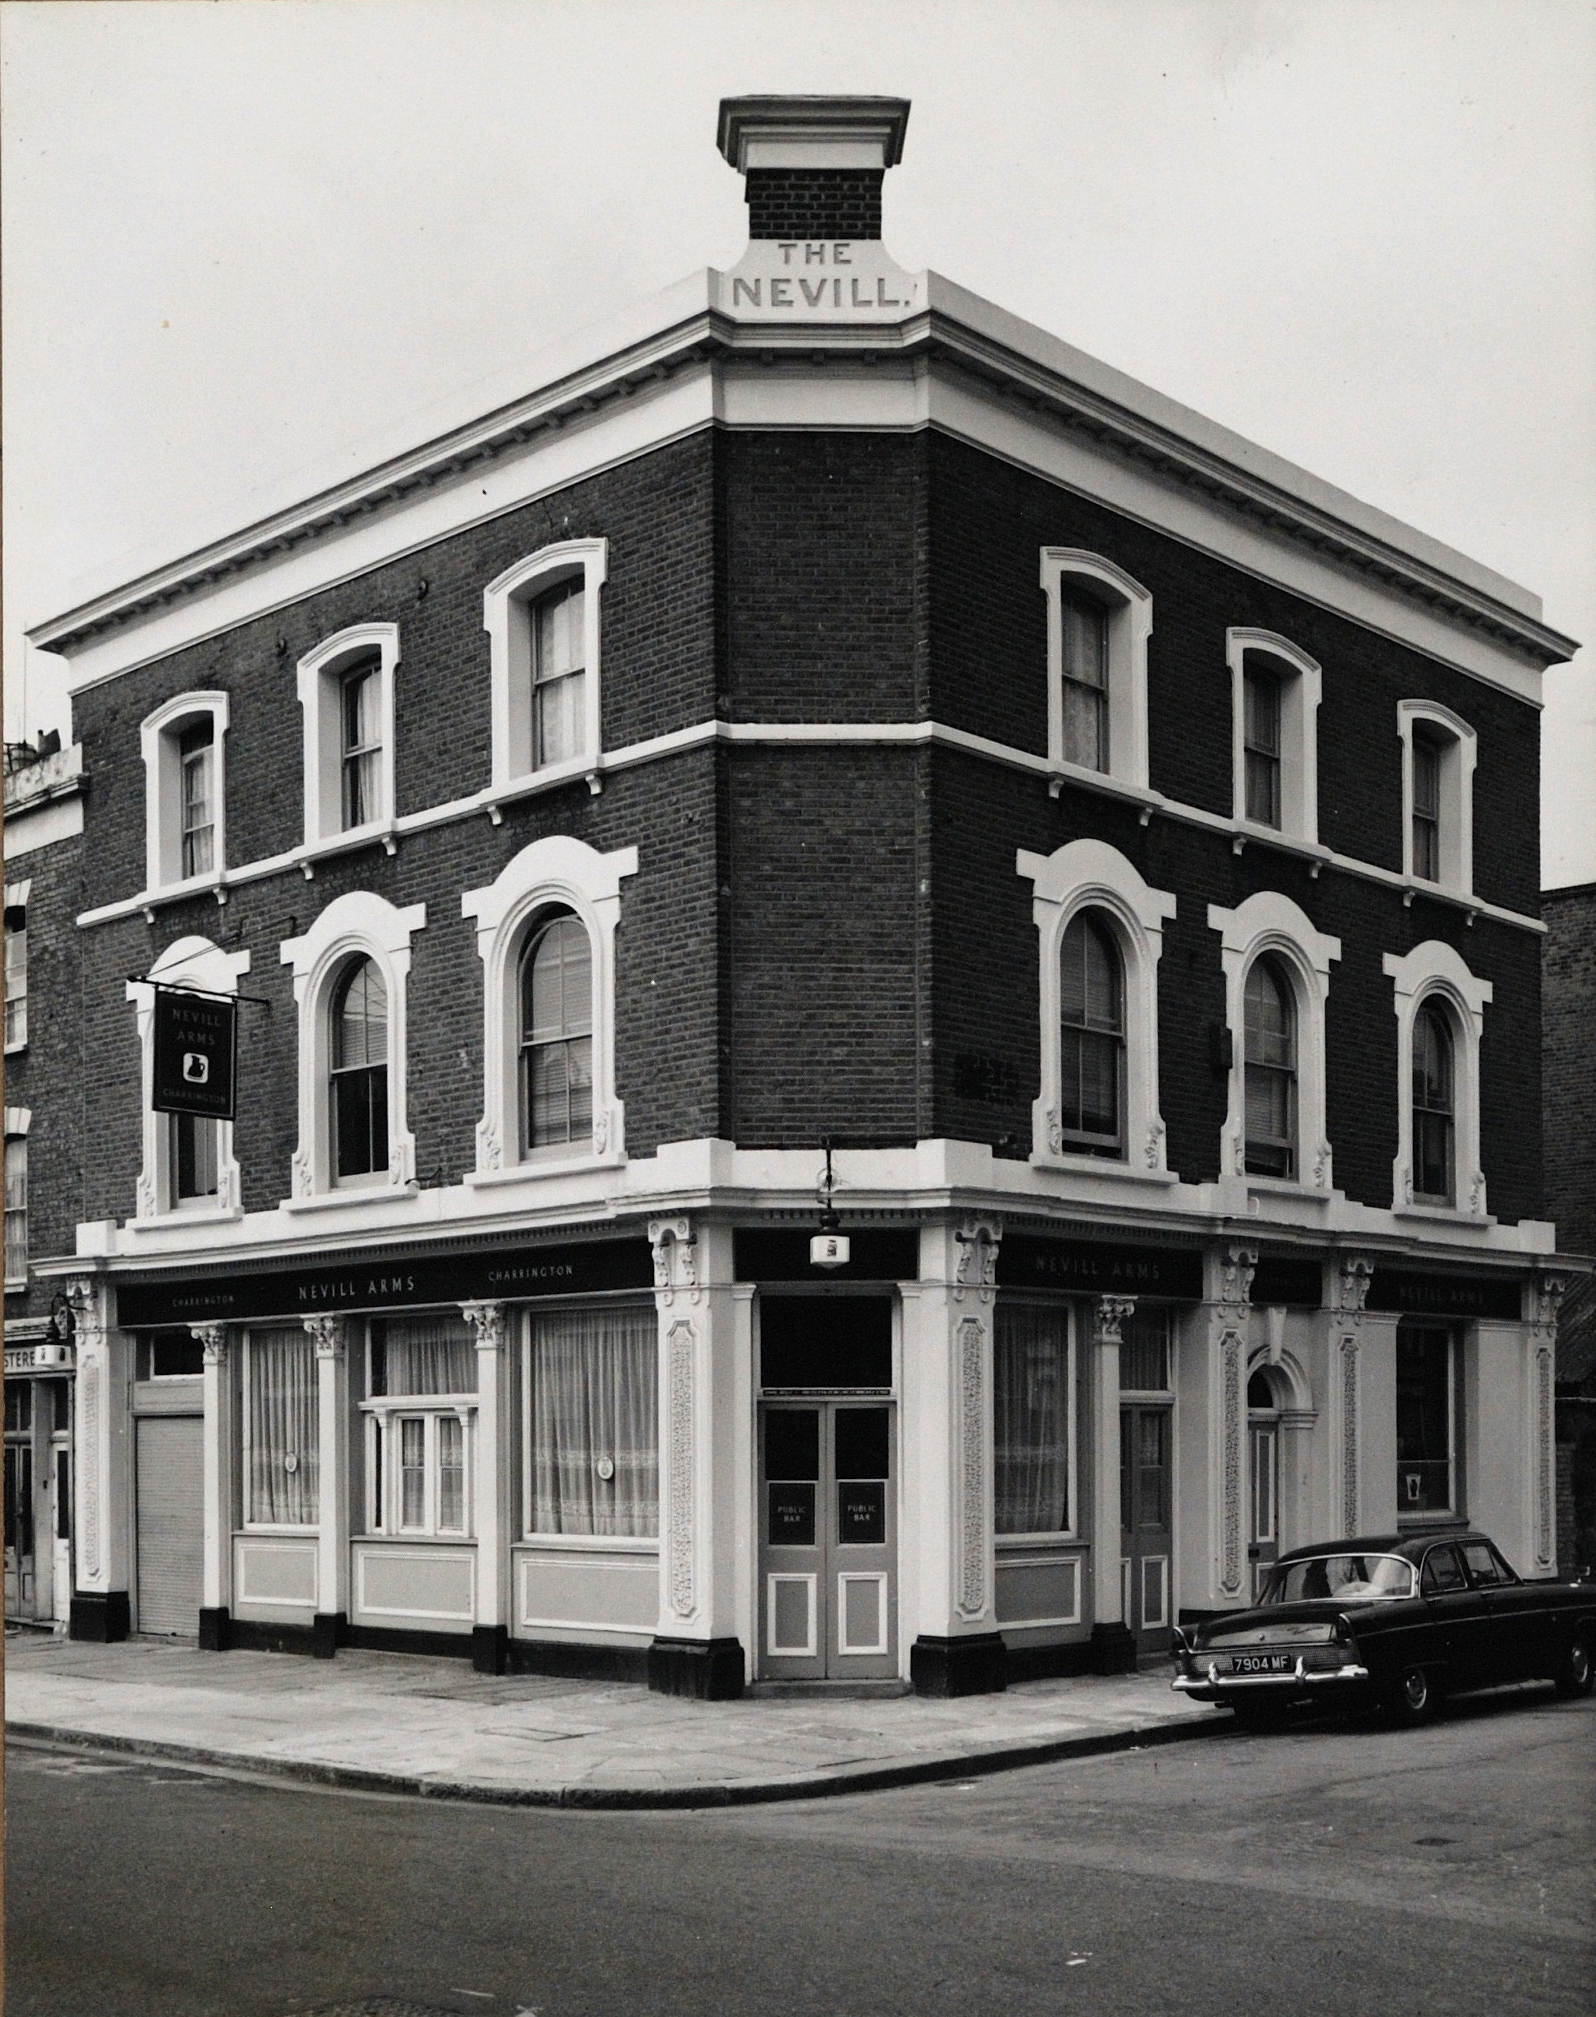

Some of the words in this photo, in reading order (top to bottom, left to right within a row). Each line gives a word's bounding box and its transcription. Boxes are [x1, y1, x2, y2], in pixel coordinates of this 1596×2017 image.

[777, 243, 852, 265] THE
[172, 1007, 221, 1028] NEVILL
[176, 1029, 215, 1046] ARMS
[487, 1264, 573, 1281] CHARRINGTON
[1035, 1255, 1099, 1276] NEVILL
[1112, 1261, 1160, 1280] ARMS
[299, 1281, 356, 1300] NEVILL
[368, 1275, 415, 1295] ARMS
[172, 1294, 235, 1308] CHARRINGTON
[777, 1505, 806, 1514] PUBLIC
[847, 1504, 877, 1513] PUBLIC
[783, 1514, 801, 1523] BAR
[853, 1513, 871, 1522] BAR
[1234, 1657, 1269, 1671] 7904
[1271, 1655, 1289, 1669] MF
